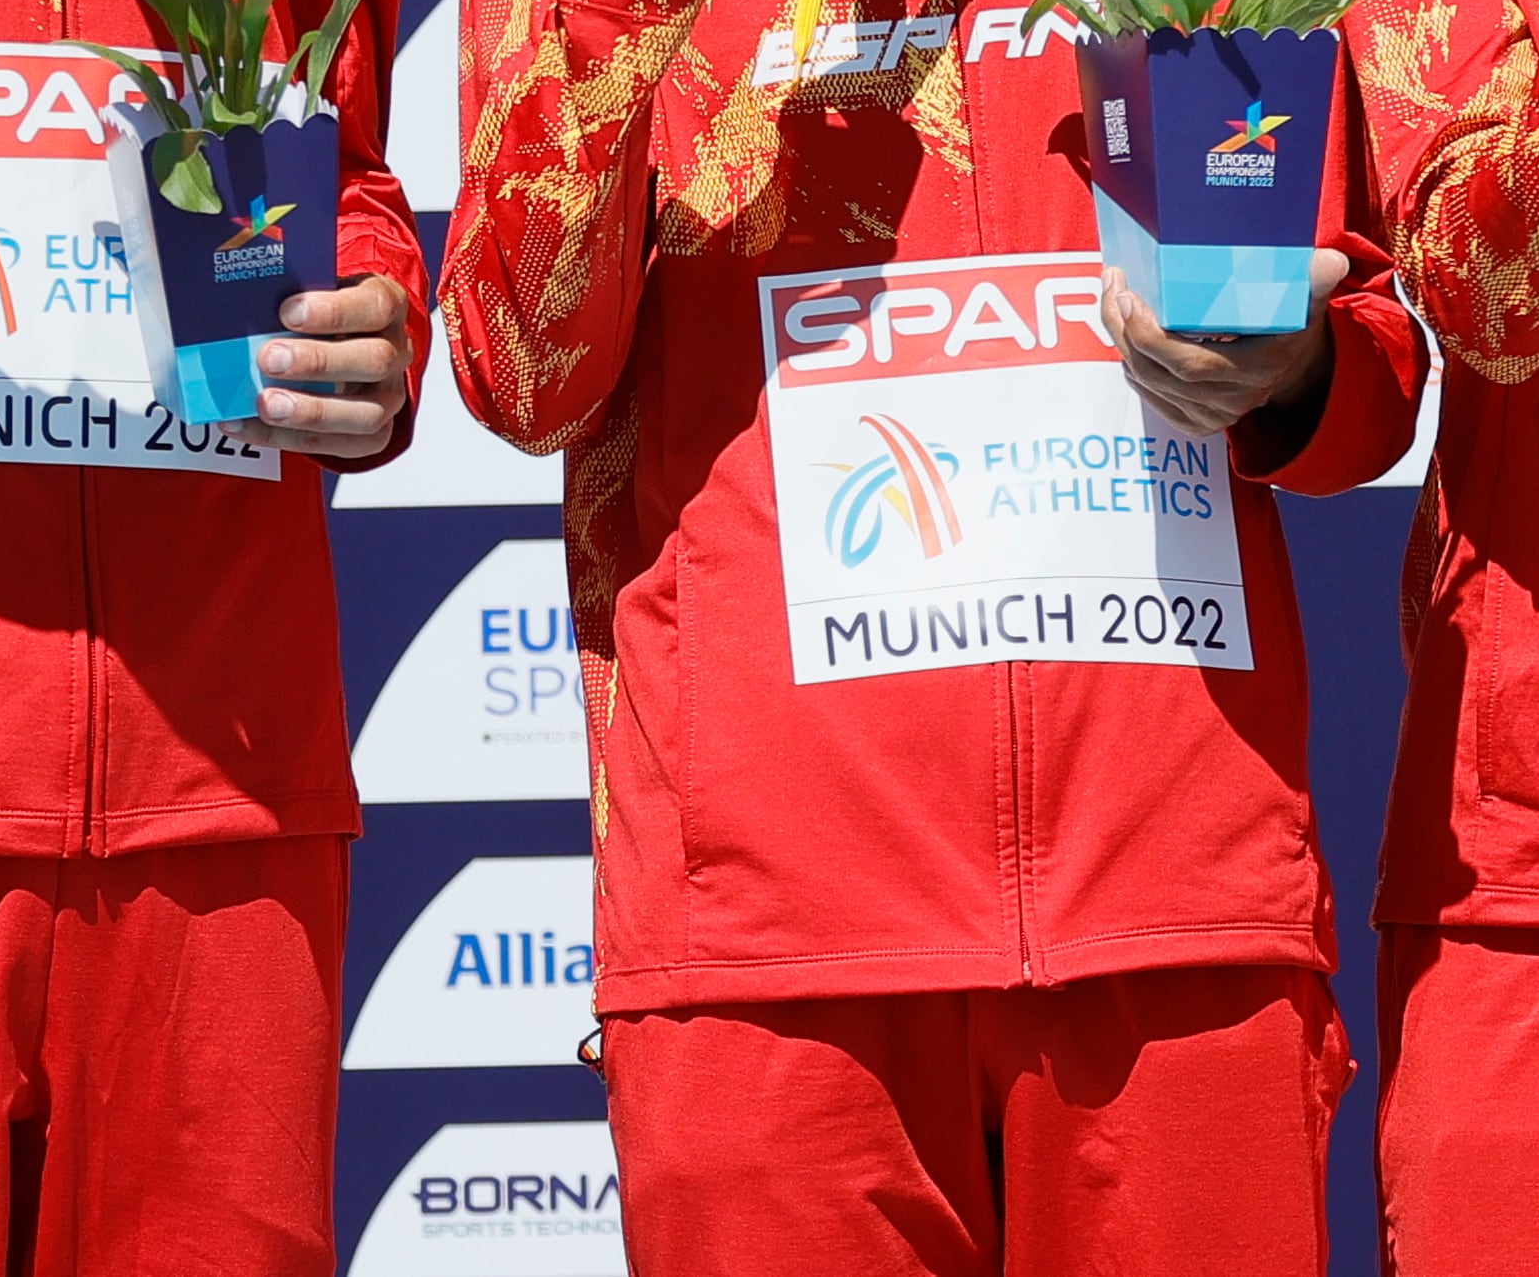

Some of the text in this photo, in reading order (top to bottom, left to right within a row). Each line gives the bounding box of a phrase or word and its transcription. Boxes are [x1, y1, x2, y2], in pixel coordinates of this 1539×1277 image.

[1206, 153, 1276, 168] EUROPEAN
[1205, 176, 1274, 187] MUNICH 2022
[1206, 166, 1275, 177] CHAMPIONSHIPS
[213, 243, 284, 265] EUROPEAN
[214, 256, 284, 274] CHAMPIONSHIPS
[214, 266, 284, 284] MUNICH 2022
[784, 275, 1116, 372] SPAR
[984, 433, 1209, 477] EUROPEAN
[988, 477, 1213, 520] ATHLETICS
[482, 607, 575, 653] EU
[823, 592, 1227, 667] MUNICH 2022
[422, 1222, 514, 1239] SPORTS
